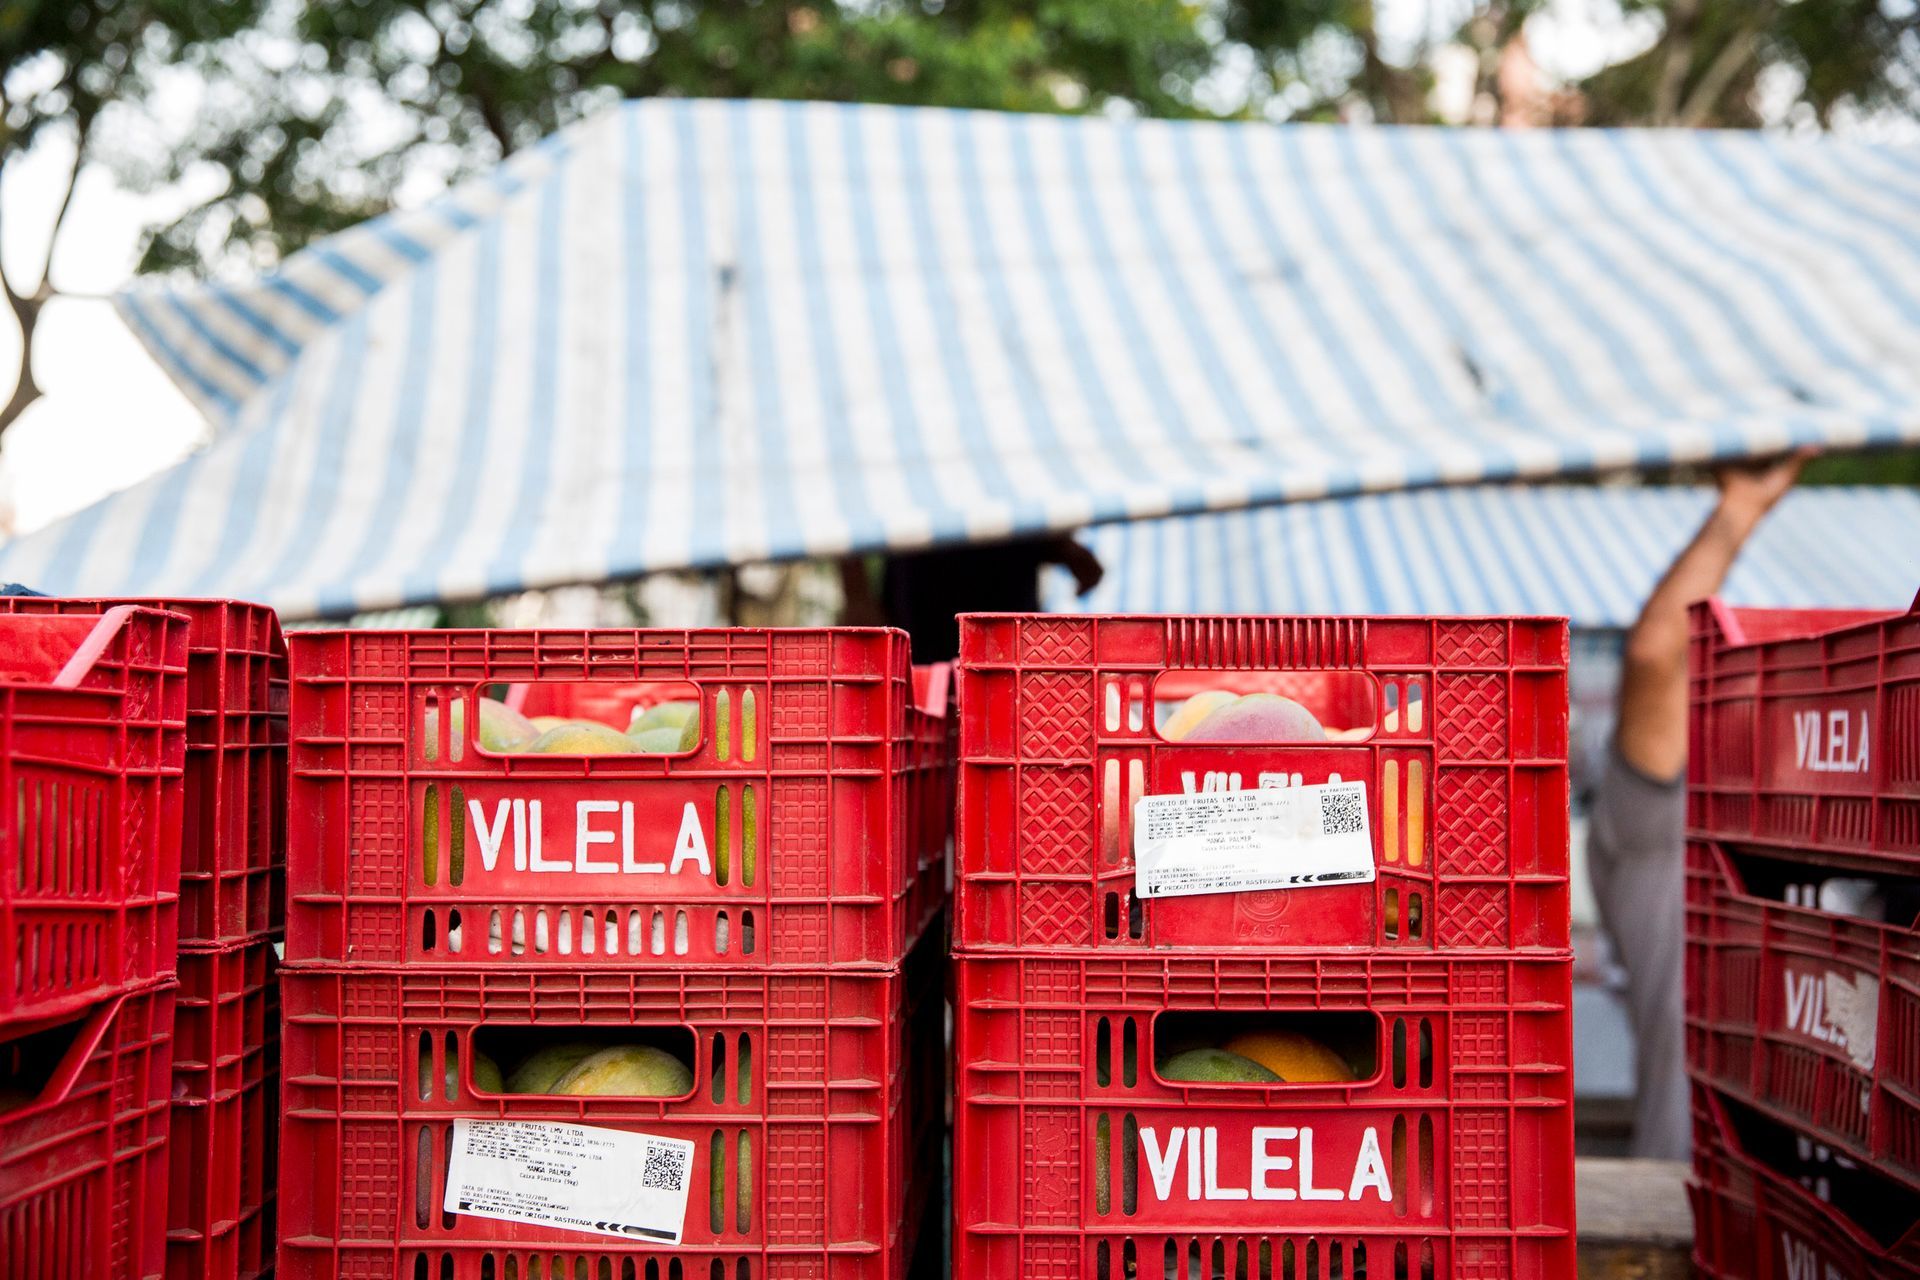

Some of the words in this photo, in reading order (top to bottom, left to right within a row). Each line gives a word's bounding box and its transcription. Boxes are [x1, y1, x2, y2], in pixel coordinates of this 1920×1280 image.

[1789, 706, 1870, 757] VILELA
[468, 798, 712, 876] VILELA
[521, 1123, 546, 1131] FRUTAS
[566, 1129, 584, 1137] LTDA
[526, 1165, 545, 1173] MANGA
[548, 1167, 571, 1177] PALMER
[1139, 1126, 1393, 1202] VILELA
[474, 1204, 504, 1213] PRODUTO
[524, 1211, 550, 1220] ORIGEM
[553, 1215, 592, 1226] RASTREADA
